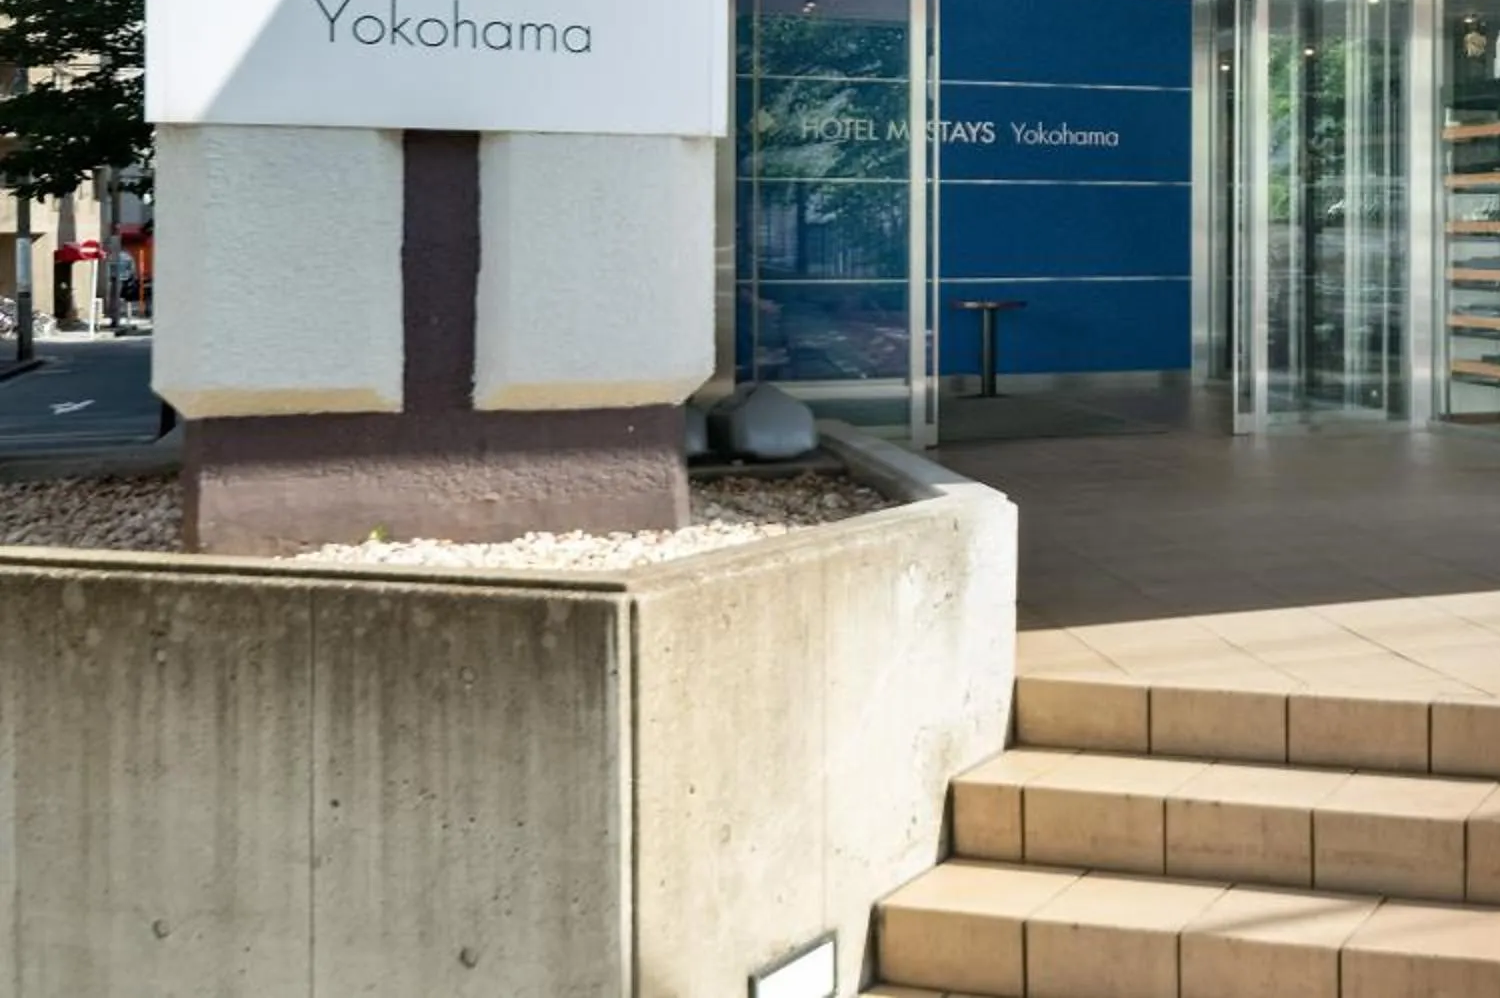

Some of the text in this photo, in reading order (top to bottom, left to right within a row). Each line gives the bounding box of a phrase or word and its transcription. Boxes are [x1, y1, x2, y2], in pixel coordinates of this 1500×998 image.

[801, 118, 1119, 147] HOTEL MSTAYS Yokohama
